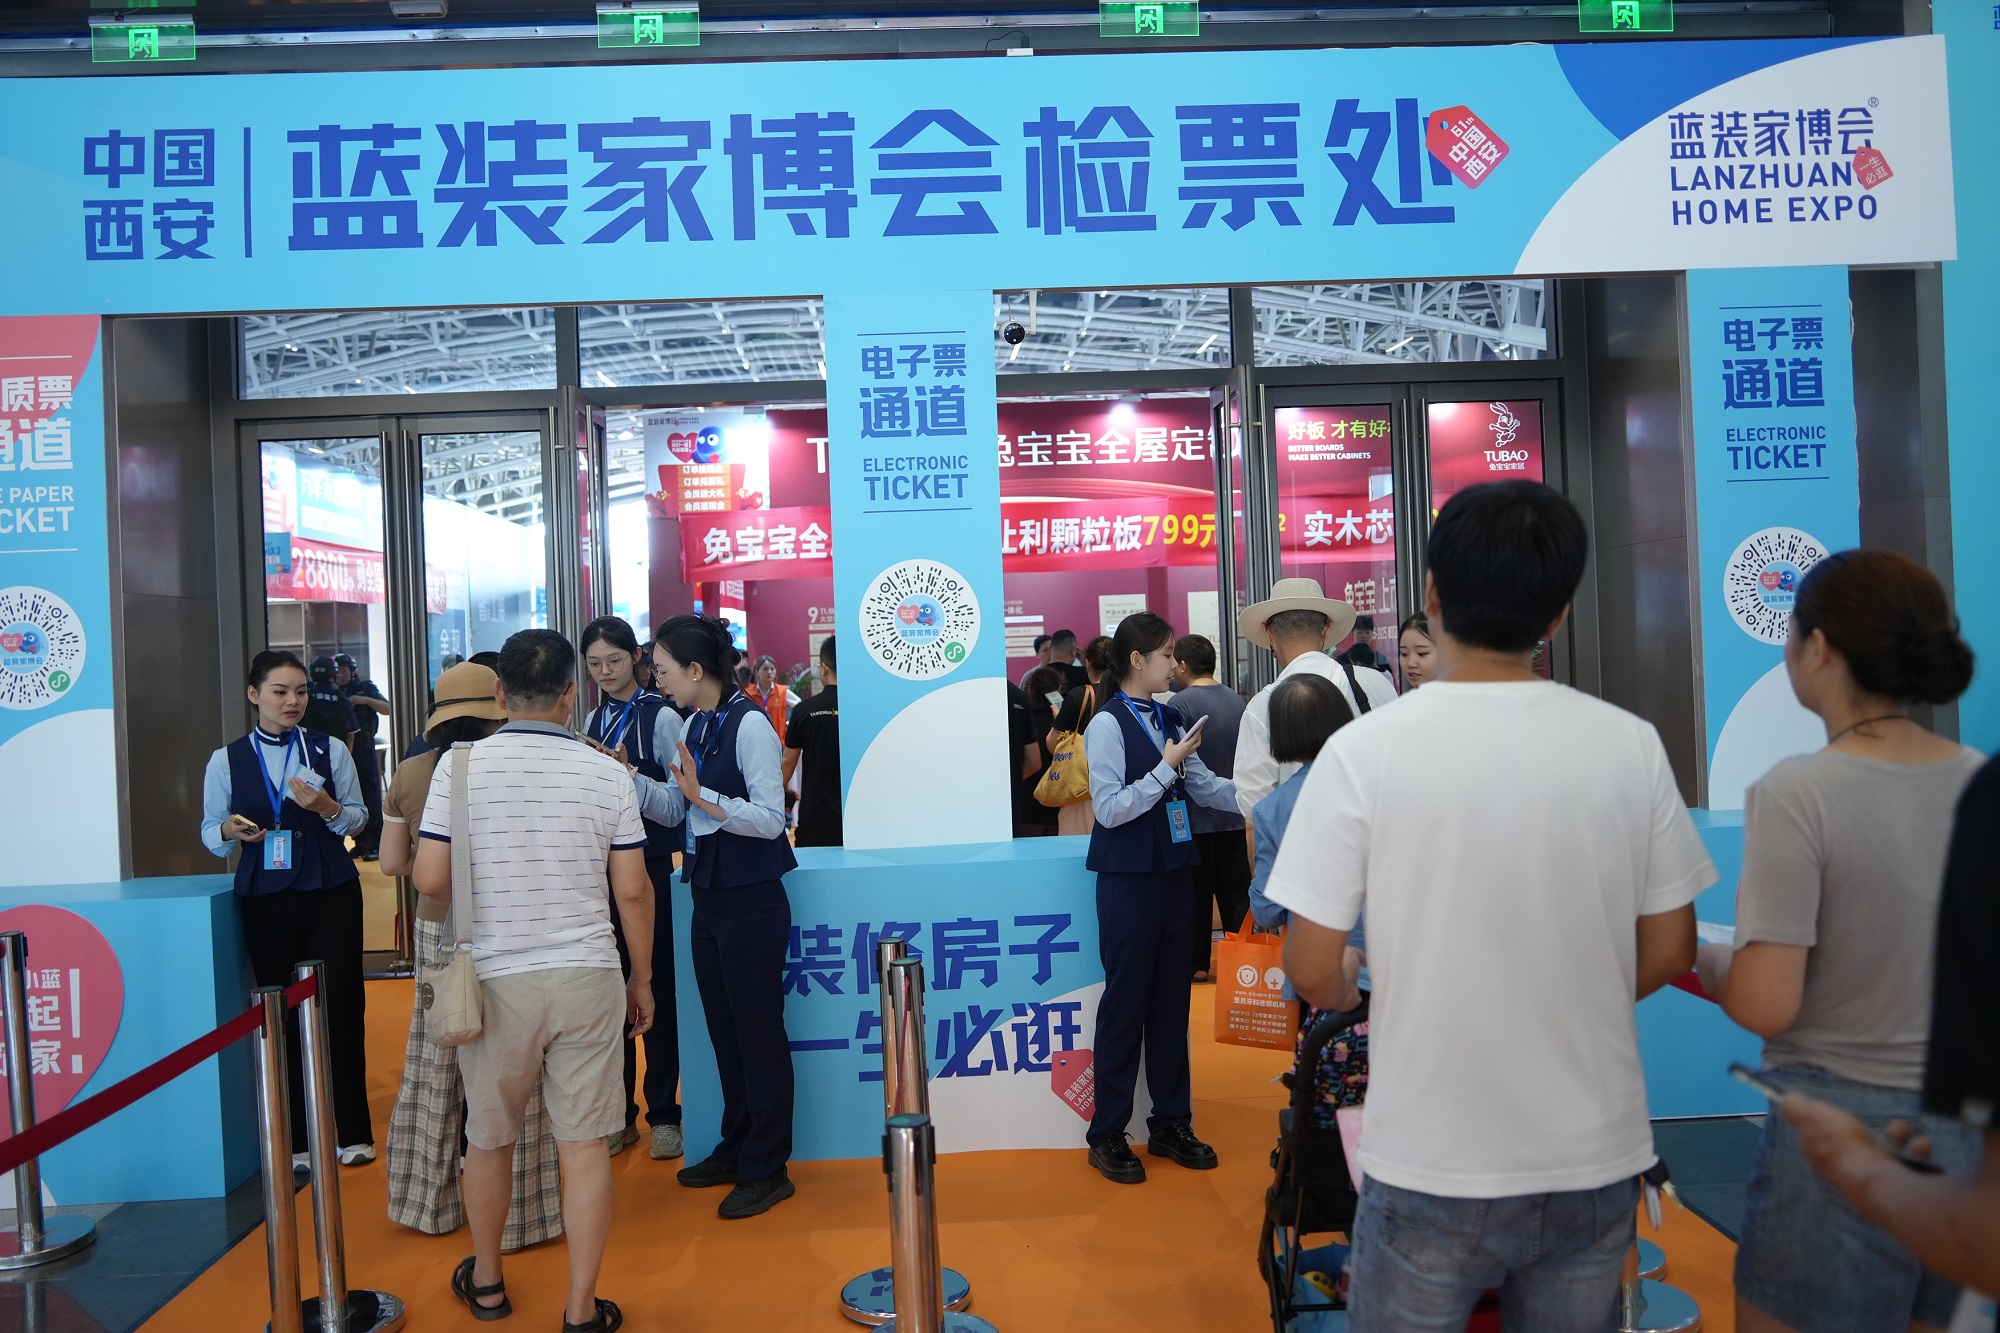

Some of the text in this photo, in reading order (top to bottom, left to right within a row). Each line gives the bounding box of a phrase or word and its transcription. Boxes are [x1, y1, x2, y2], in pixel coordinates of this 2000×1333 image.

[1450, 116, 1475, 138] 61th
[1448, 124, 1488, 164] 中国
[83, 97, 1456, 252] 中国 蓝装家博会检票处
[1462, 140, 1503, 181] 西安
[1671, 160, 1862, 192] LANZHUAN
[1672, 193, 1878, 226] HOME EXPO
[83, 197, 216, 261] 西安
[1723, 316, 1824, 352] 电子票
[860, 342, 967, 380] 电子票
[1722, 357, 1826, 411] 通道
[859, 384, 968, 440] 通道
[1286, 418, 1391, 441] 好板 才有好
[1726, 426, 1827, 442] ELECTRONIC
[998, 425, 1214, 468] 兔宝宝全屋定
[1287, 443, 1344, 453] BETTER BOARDS
[1288, 451, 1371, 462] MAKE BETTER CABINETS
[1483, 449, 1529, 463] TUBAO
[1726, 443, 1827, 471] TICKET
[863, 455, 969, 472] ELECTRONIC
[9, 485, 74, 504] PAPER
[863, 473, 969, 501] TICKET
[782, 913, 1081, 998] 装修房子
[1073, 1080, 1094, 1107] LANZH
